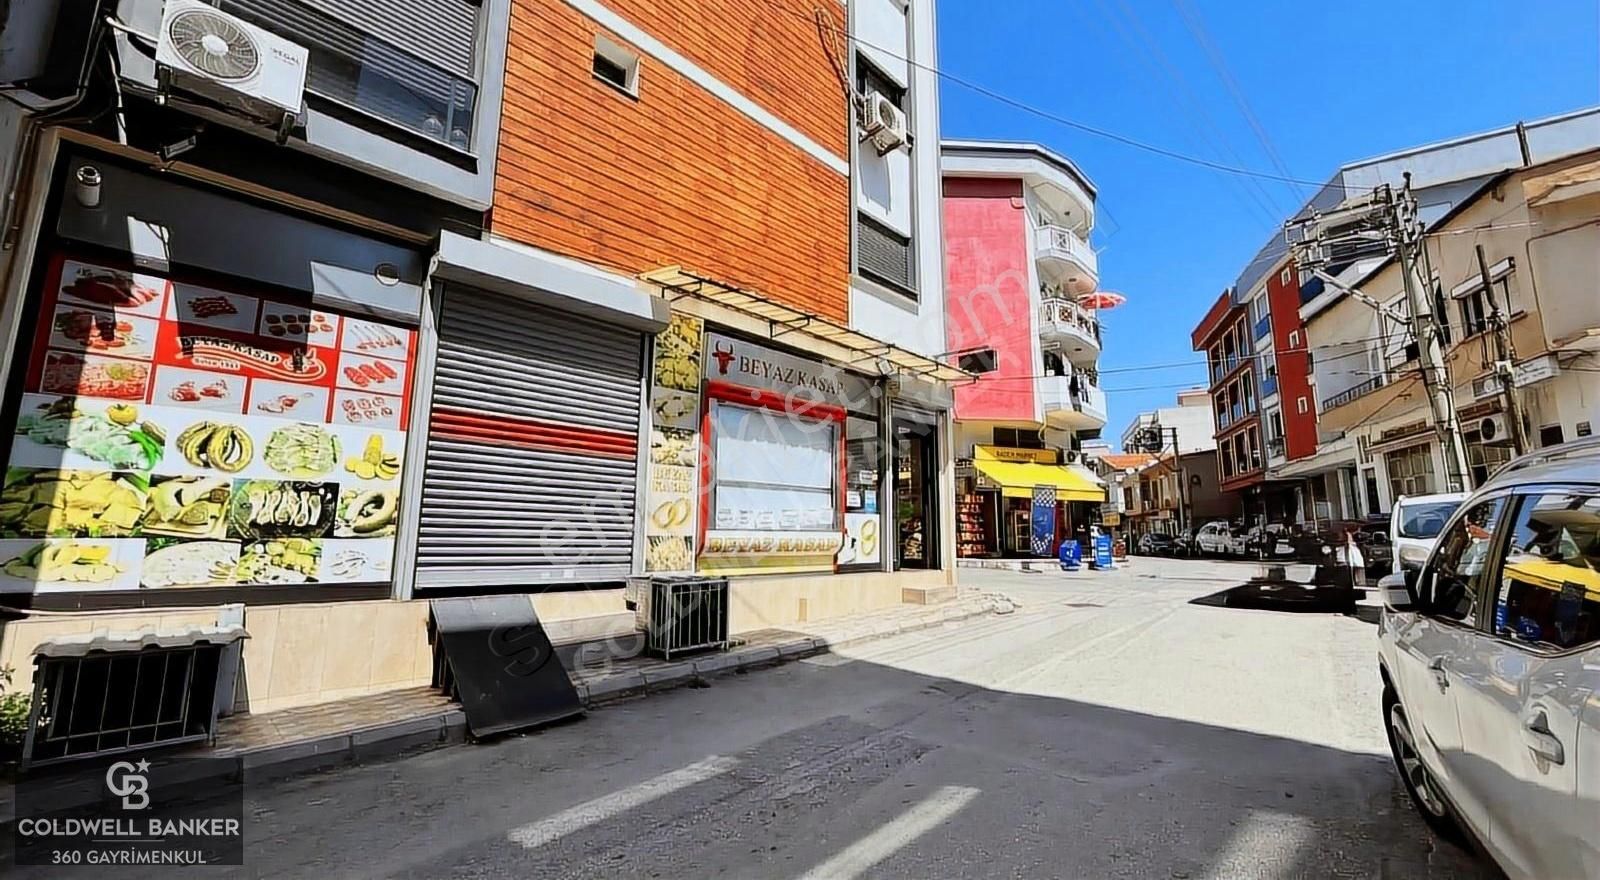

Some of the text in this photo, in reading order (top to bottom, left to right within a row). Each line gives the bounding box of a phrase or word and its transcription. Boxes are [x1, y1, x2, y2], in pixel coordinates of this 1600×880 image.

[739, 355, 845, 396] BEYAZ KASAP
[707, 536, 839, 553] BEYAZ KASAP
